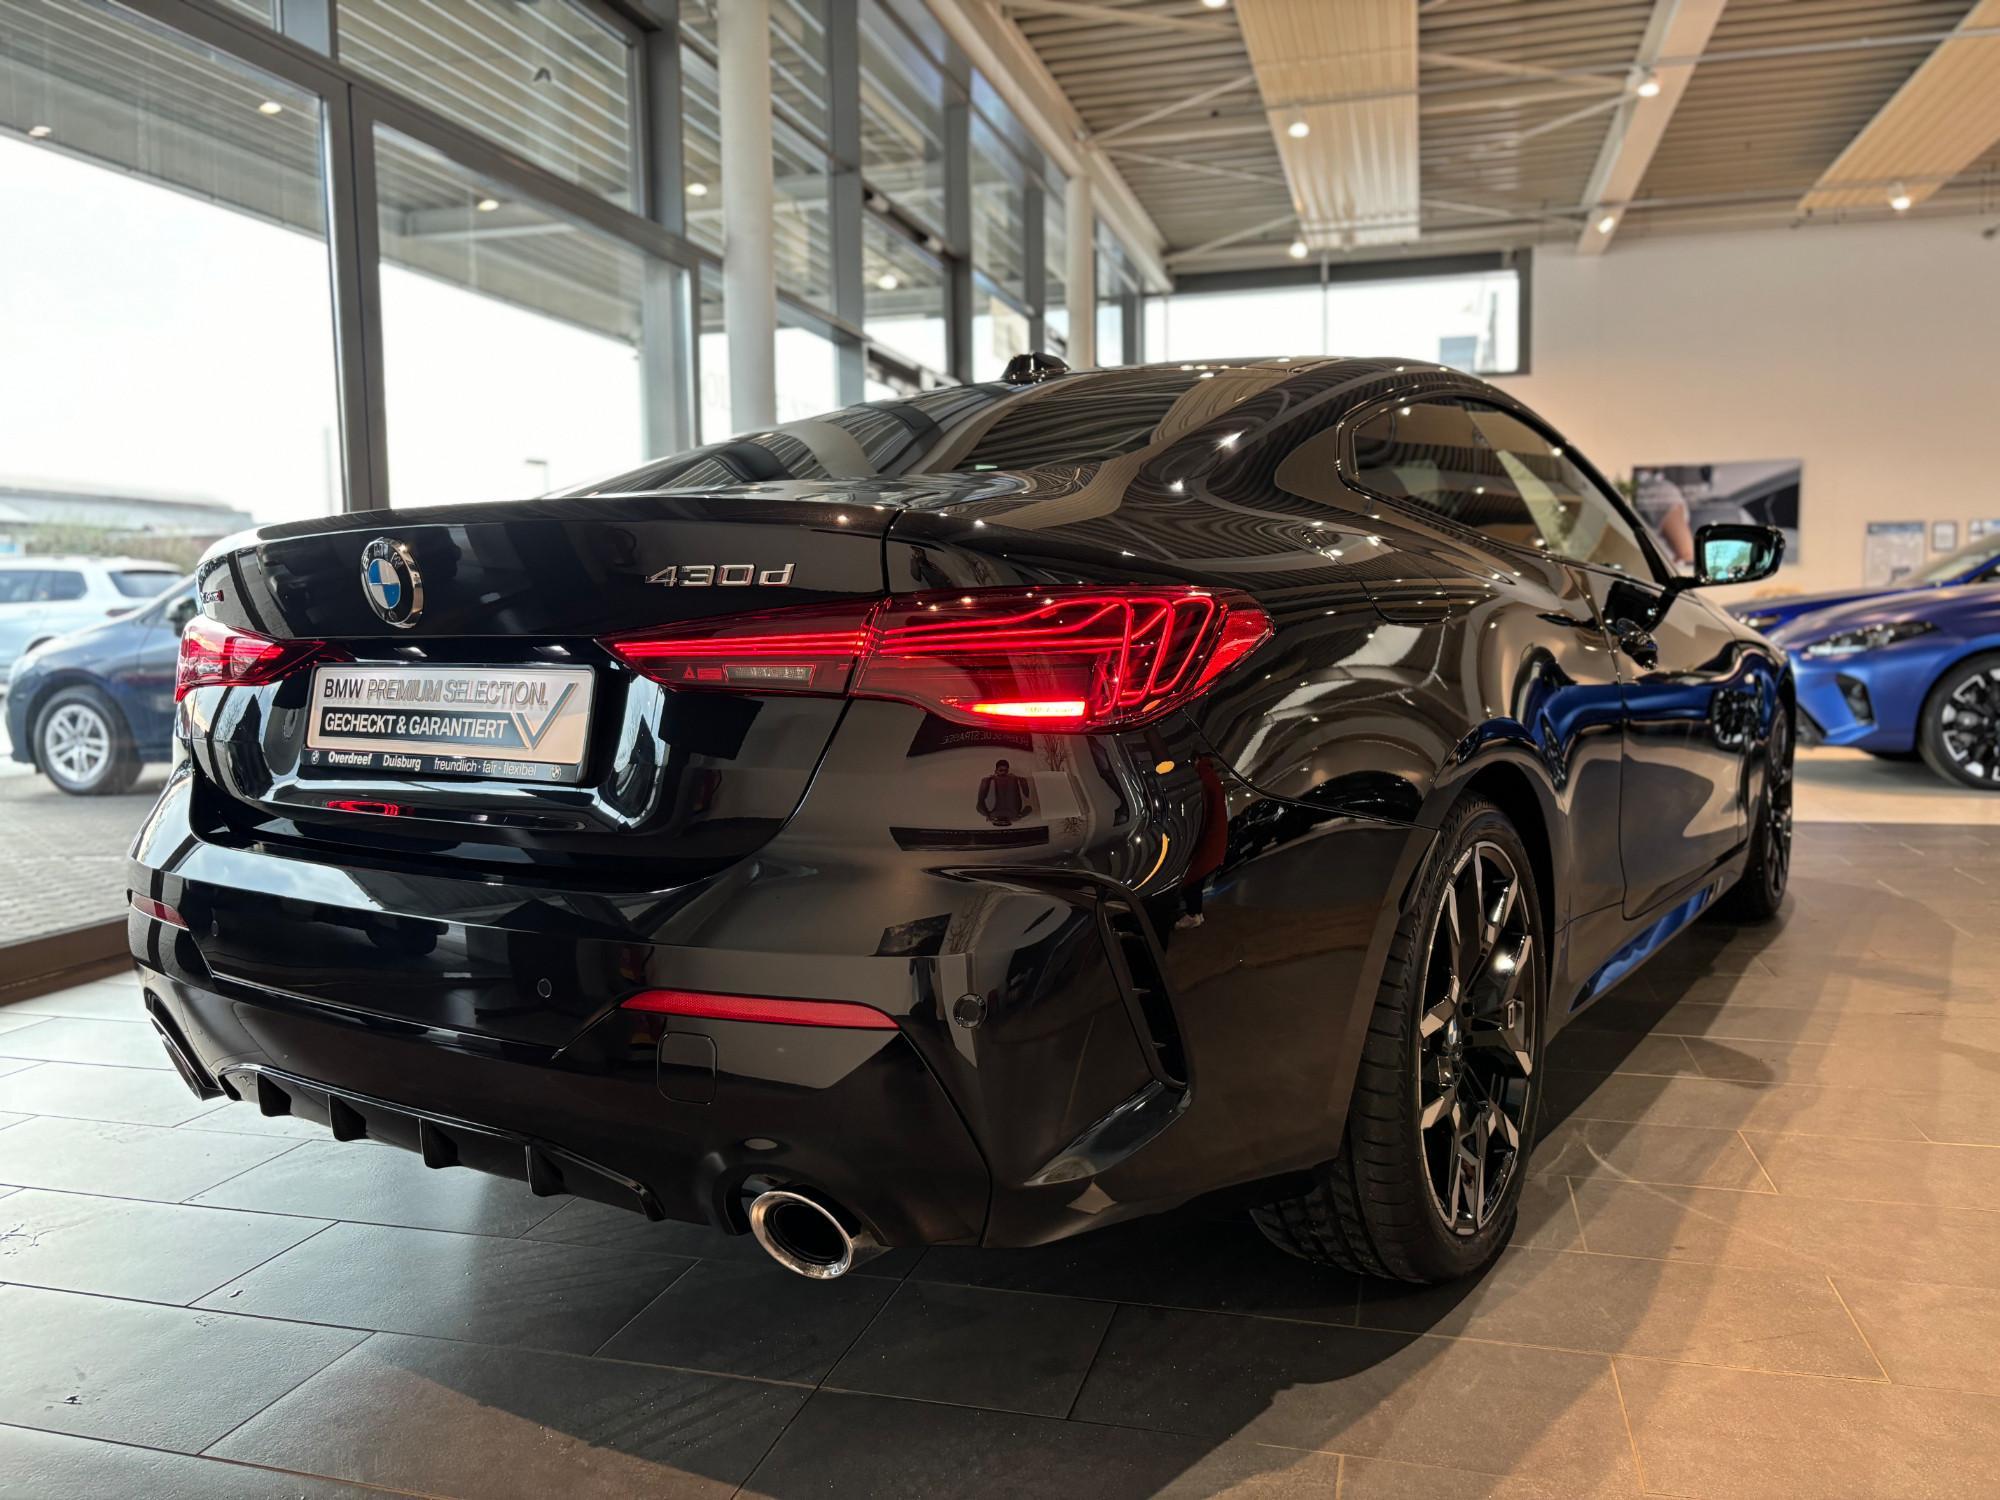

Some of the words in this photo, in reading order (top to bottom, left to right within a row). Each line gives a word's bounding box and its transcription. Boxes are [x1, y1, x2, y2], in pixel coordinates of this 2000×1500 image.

[645, 563, 796, 587] 430d
[323, 678, 364, 699] BMW
[367, 679, 442, 702] PREMIUM
[443, 679, 548, 706] SELECTION.
[325, 713, 396, 733] GECHECKT
[396, 715, 407, 734] &
[409, 716, 508, 739] GARANTIERT
[328, 751, 372, 765] Overdreef
[383, 754, 421, 771] Duisburg
[434, 757, 477, 773] freundlich
[482, 760, 497, 774] fair
[503, 762, 537, 777] flexibel
